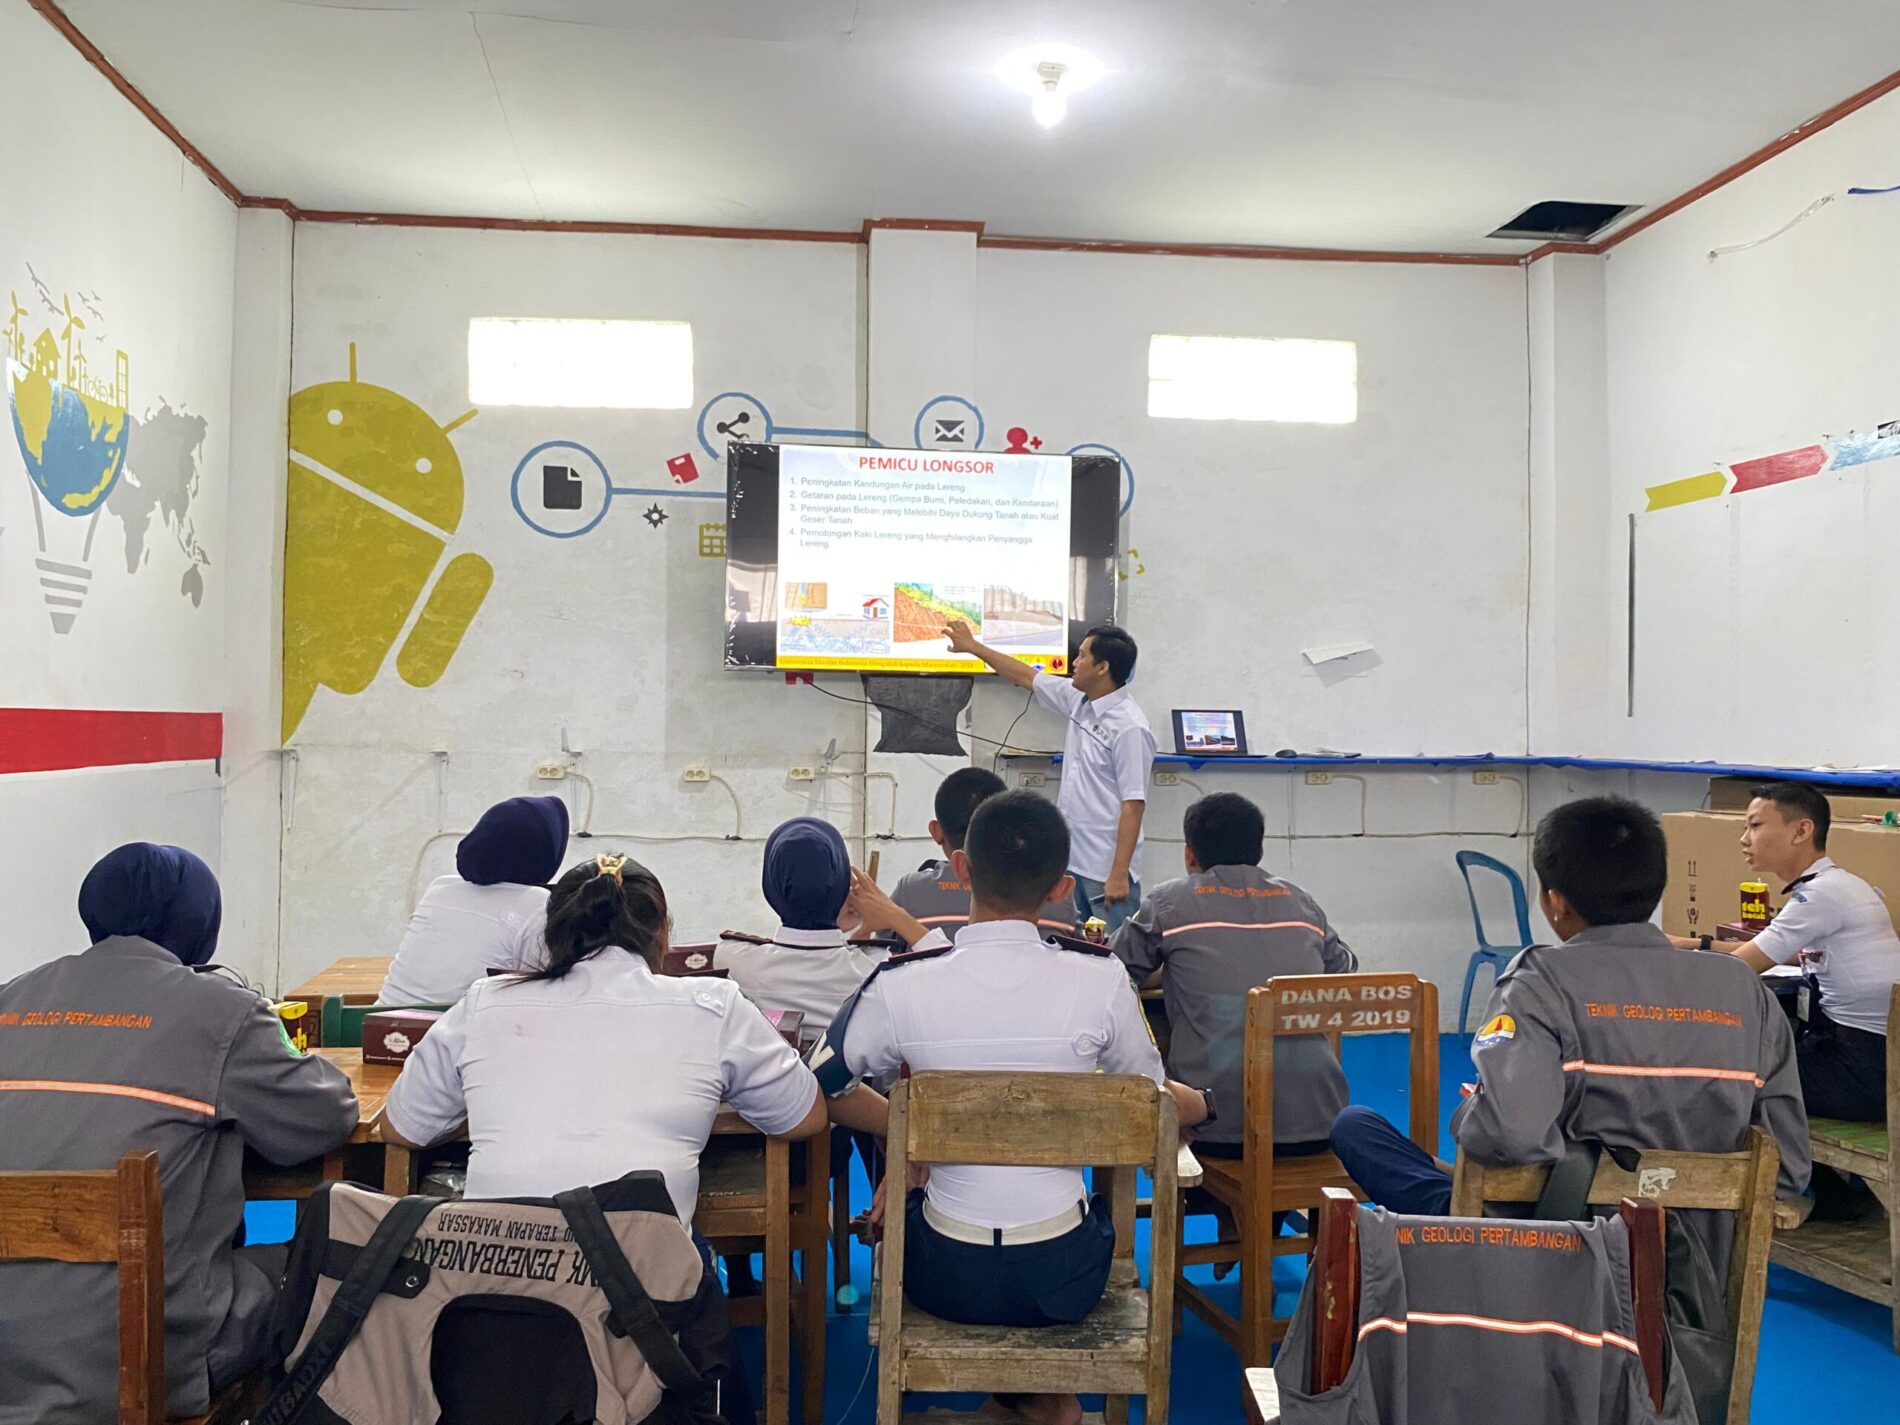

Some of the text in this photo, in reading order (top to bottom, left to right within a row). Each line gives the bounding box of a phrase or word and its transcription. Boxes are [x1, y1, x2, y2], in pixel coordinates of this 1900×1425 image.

[859, 456, 994, 474] PEMICU LONGSOR
[790, 477, 965, 493] 1. Peningkatan Kandungan Air pada Lereng
[789, 490, 797, 499] 2.
[801, 490, 834, 500] Getaran
[836, 492, 857, 502] pada
[859, 492, 887, 503] Lereng
[889, 494, 922, 504] (Gempa
[995, 498, 1010, 507] dan
[1012, 498, 1059, 509] Kendaraan)
[800, 503, 852, 514] Peningkatan
[854, 505, 880, 515] Beban
[882, 508, 901, 516] yang
[939, 508, 960, 518] Daya
[962, 510, 993, 520] Dukung
[995, 510, 1020, 520] Tanah
[1021, 512, 1039, 520] atau
[1041, 512, 1059, 521] Kuat
[800, 515, 853, 525] Geser Tanah
[800, 528, 852, 539] Pemotongan
[854, 530, 872, 538] Kaki
[874, 531, 903, 541] Lereng
[905, 533, 924, 542] yang
[800, 540, 829, 550] Lereng
[1281, 985, 1413, 1005] DANA BOS
[64, 1011, 153, 1029] PERTAMBANGAN
[1281, 1009, 1411, 1030] TW 4 2019
[1584, 1003, 1744, 1027] TEKNIK GEOLOGI PERTAMBANGAN
[438, 1212, 503, 1238] MAKASSAR
[505, 1220, 558, 1242] TERAPAN
[1421, 1226, 1475, 1243] GEOLOGI
[1480, 1227, 1582, 1252] PERTAMBANGAN
[414, 1237, 565, 1282] PENERBANGAN
